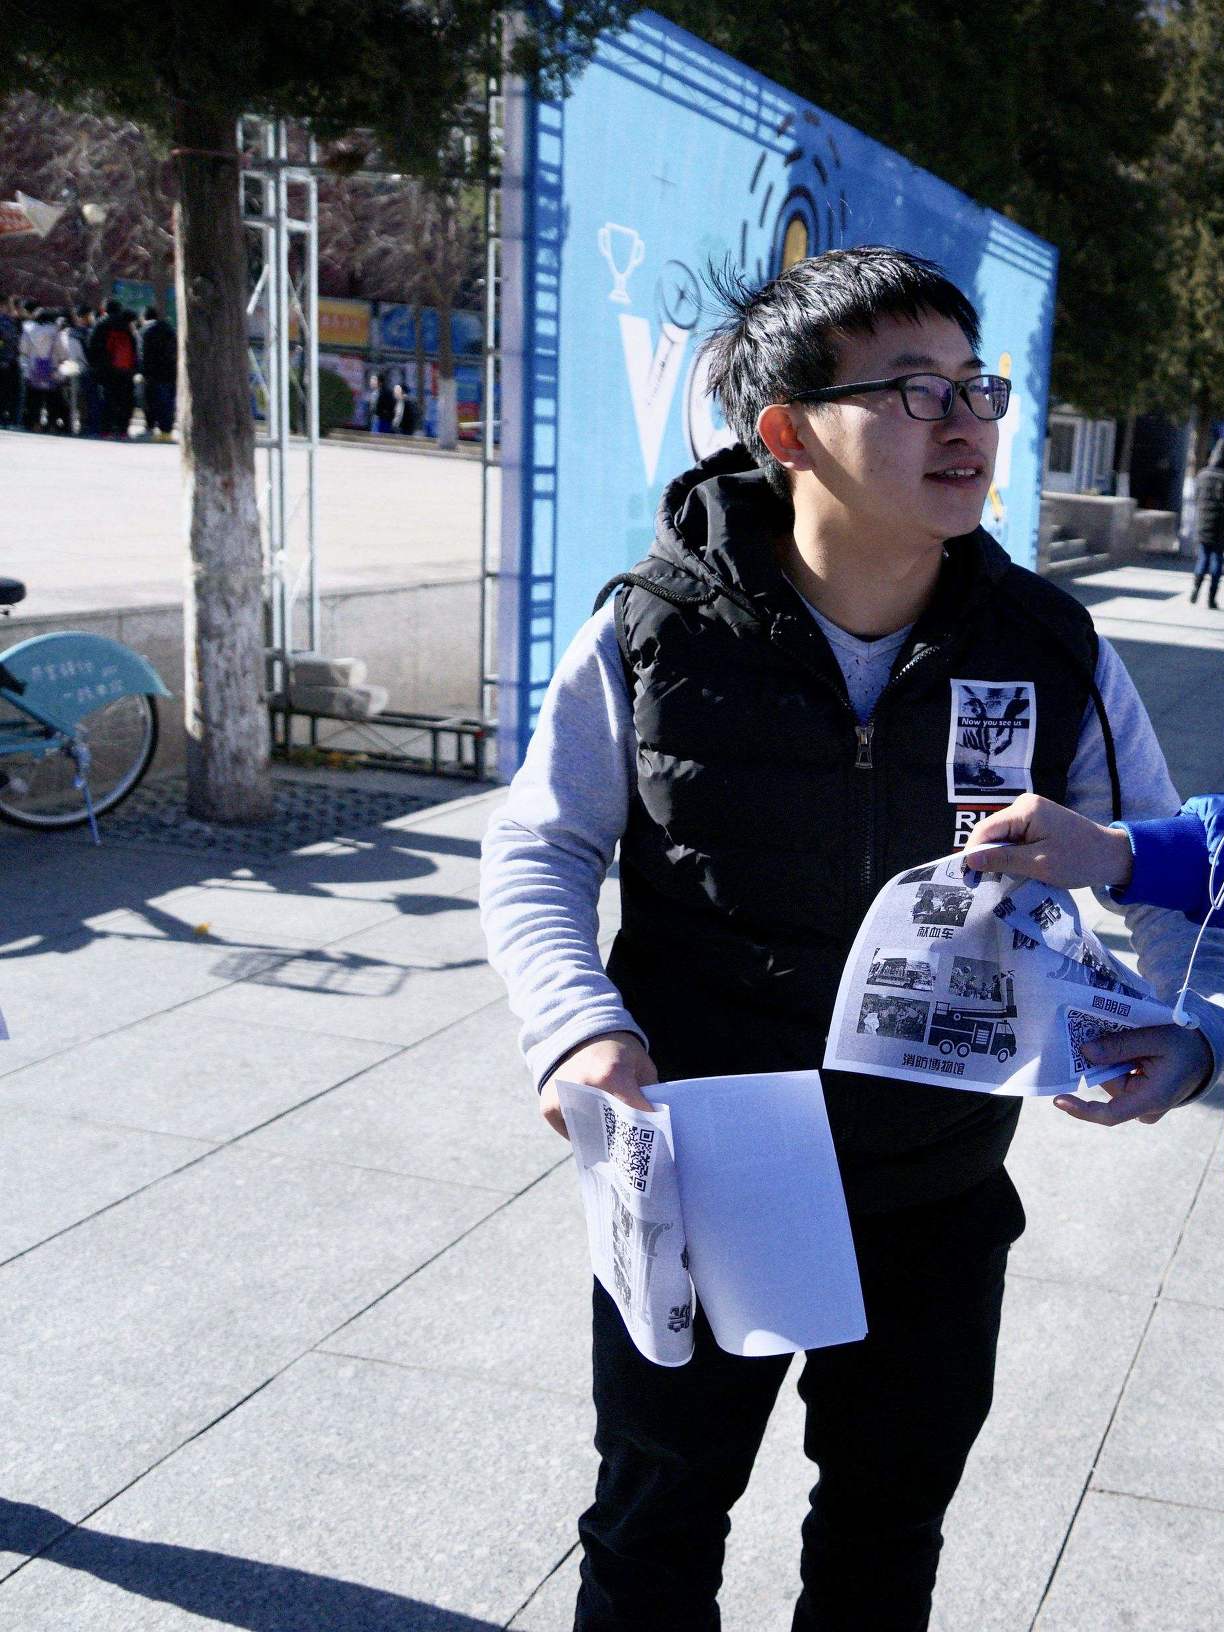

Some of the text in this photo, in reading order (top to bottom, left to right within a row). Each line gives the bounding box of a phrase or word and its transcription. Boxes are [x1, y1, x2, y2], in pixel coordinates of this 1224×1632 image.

[961, 717, 980, 726] Now
[983, 720, 997, 728] you
[917, 926, 954, 939] 献血车
[1092, 996, 1131, 1017] 圆明园
[901, 1053, 966, 1075] 消防博物馆
